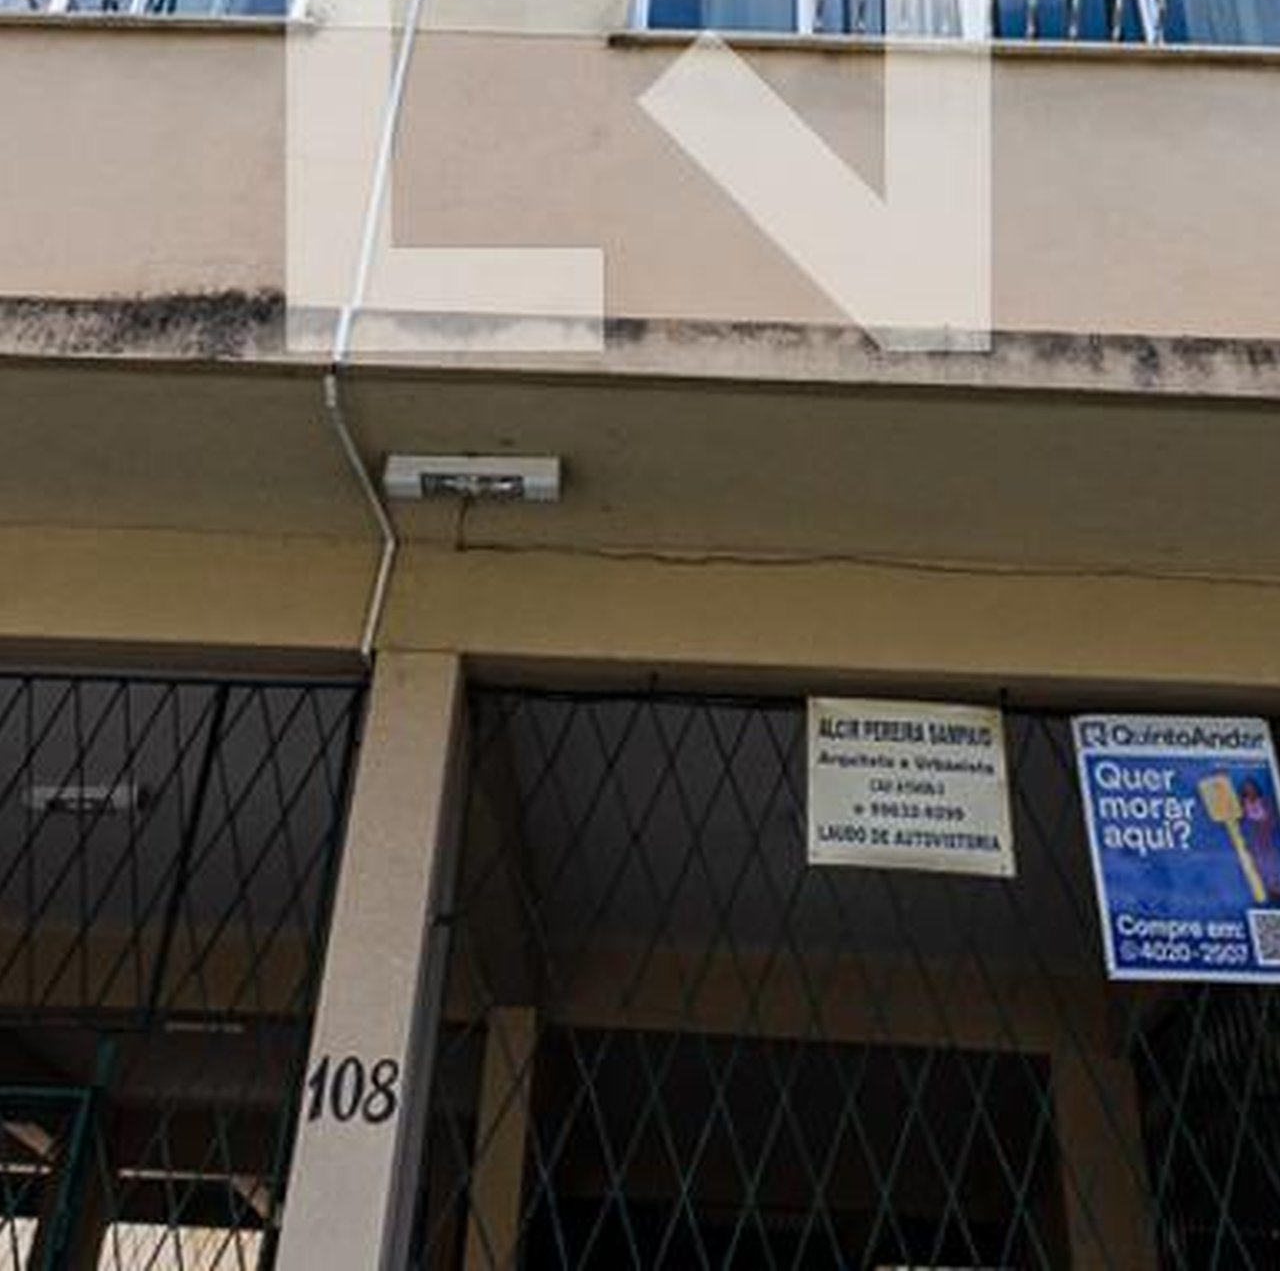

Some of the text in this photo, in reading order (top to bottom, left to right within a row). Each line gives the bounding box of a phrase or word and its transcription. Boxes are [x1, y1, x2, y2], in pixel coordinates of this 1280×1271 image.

[863, 718, 924, 743] PEREIRA
[929, 722, 992, 747] SAMPAIO
[1112, 723, 1267, 749] QuintoAndar
[915, 756, 995, 775] Urbanista
[1094, 761, 1176, 791] Quer
[1098, 795, 1197, 821] morar
[819, 825, 867, 844] LAUDO
[871, 828, 891, 845] DE
[1102, 820, 1193, 857] aqui?
[1116, 914, 1204, 941] Compre
[307, 1054, 400, 1125] 108
